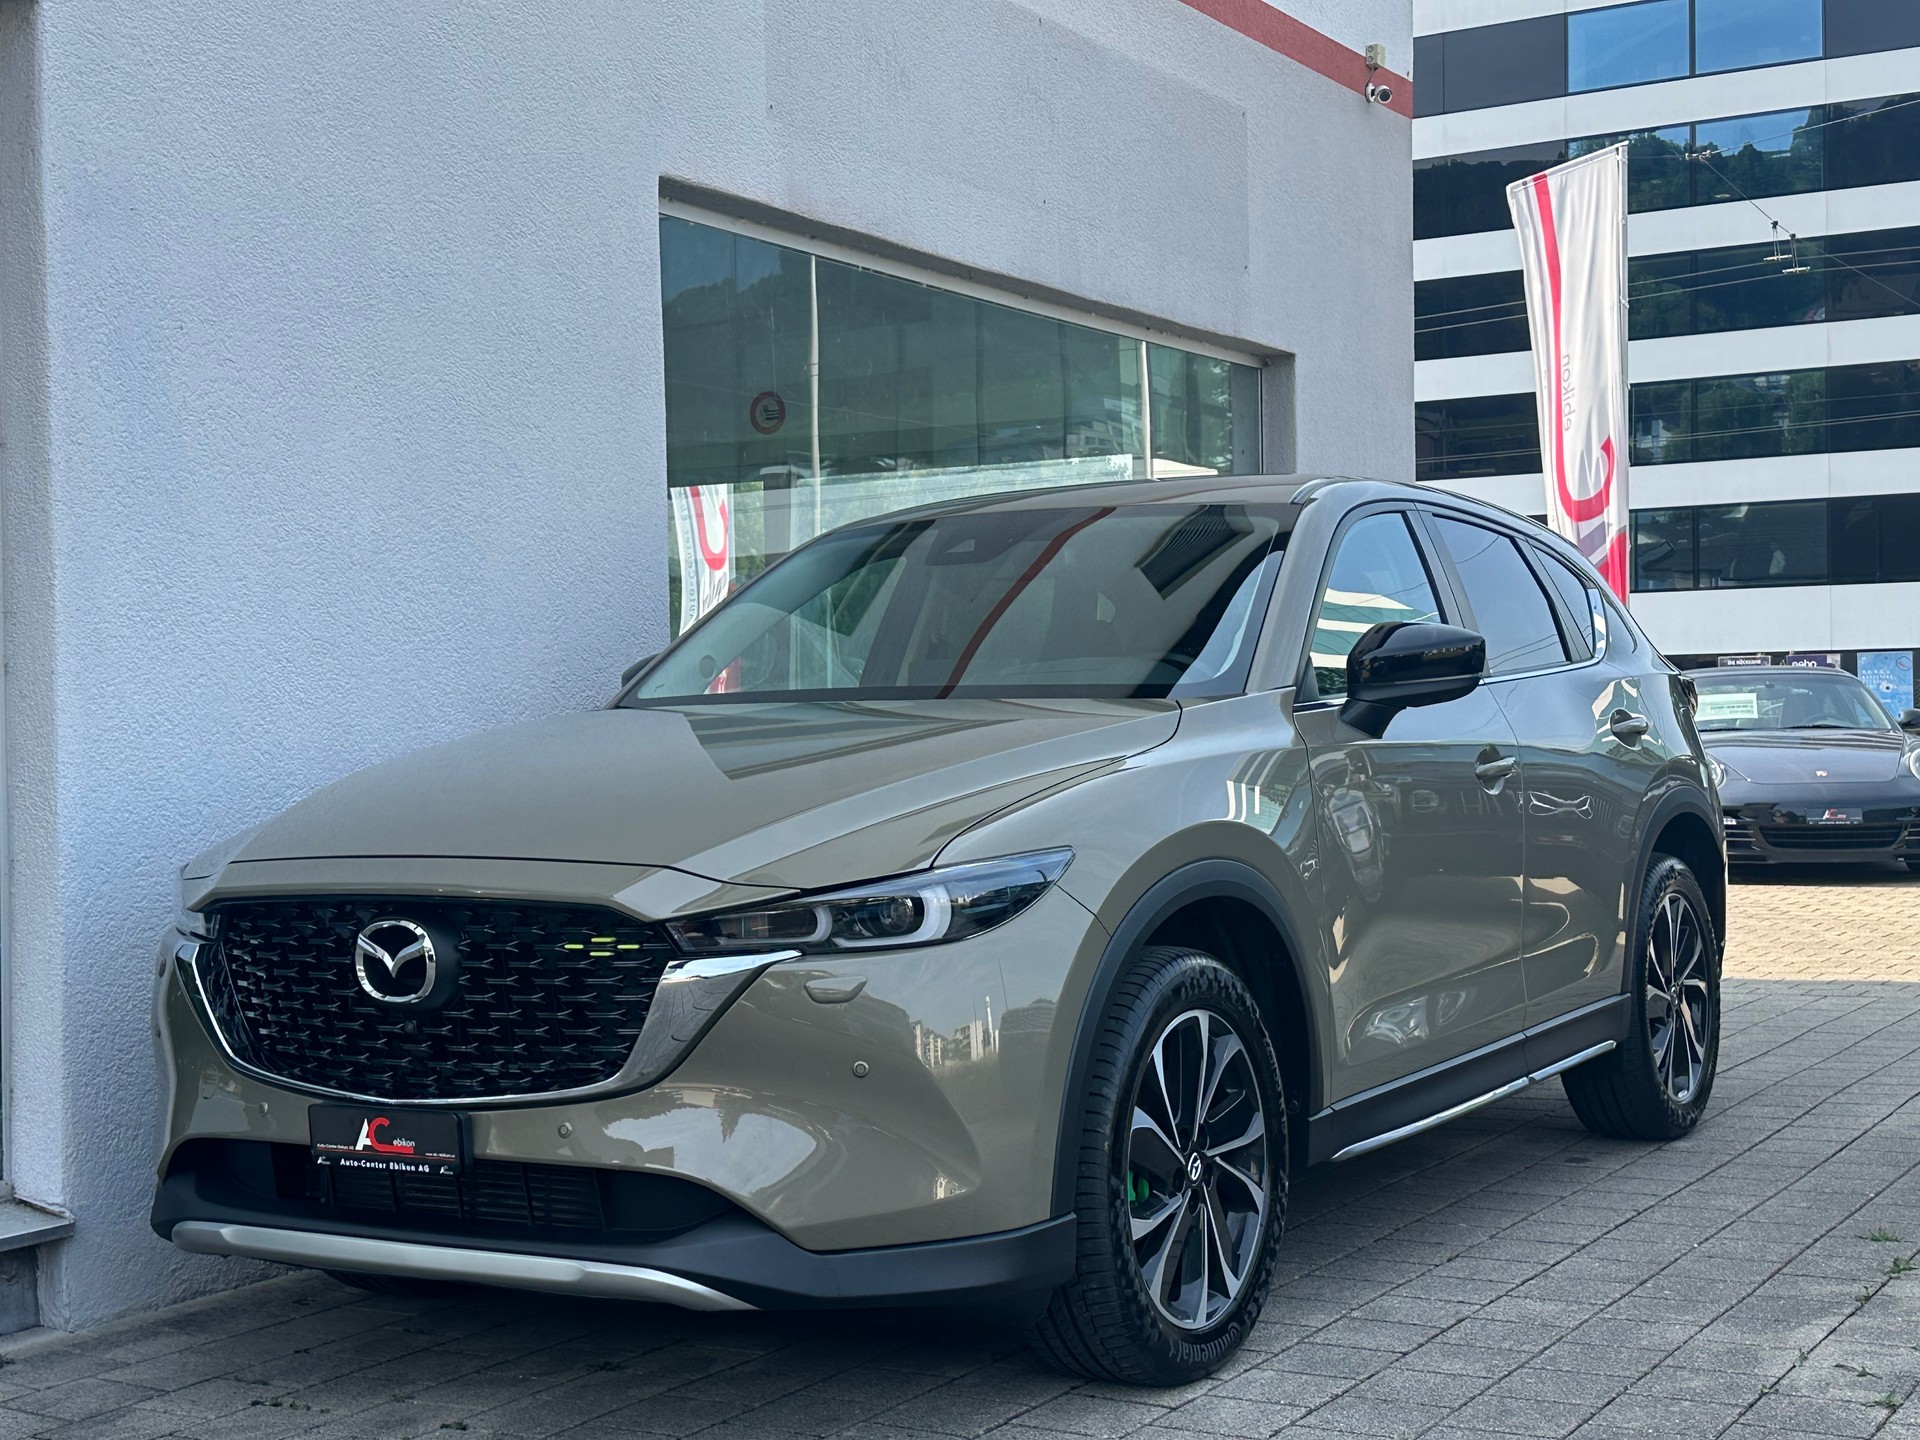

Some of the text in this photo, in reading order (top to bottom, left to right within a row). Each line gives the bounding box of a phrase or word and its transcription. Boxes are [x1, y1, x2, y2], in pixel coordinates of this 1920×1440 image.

[392, 1137, 416, 1147] ebikon
[340, 1158, 430, 1173] Auto-Center Ebikon AG
